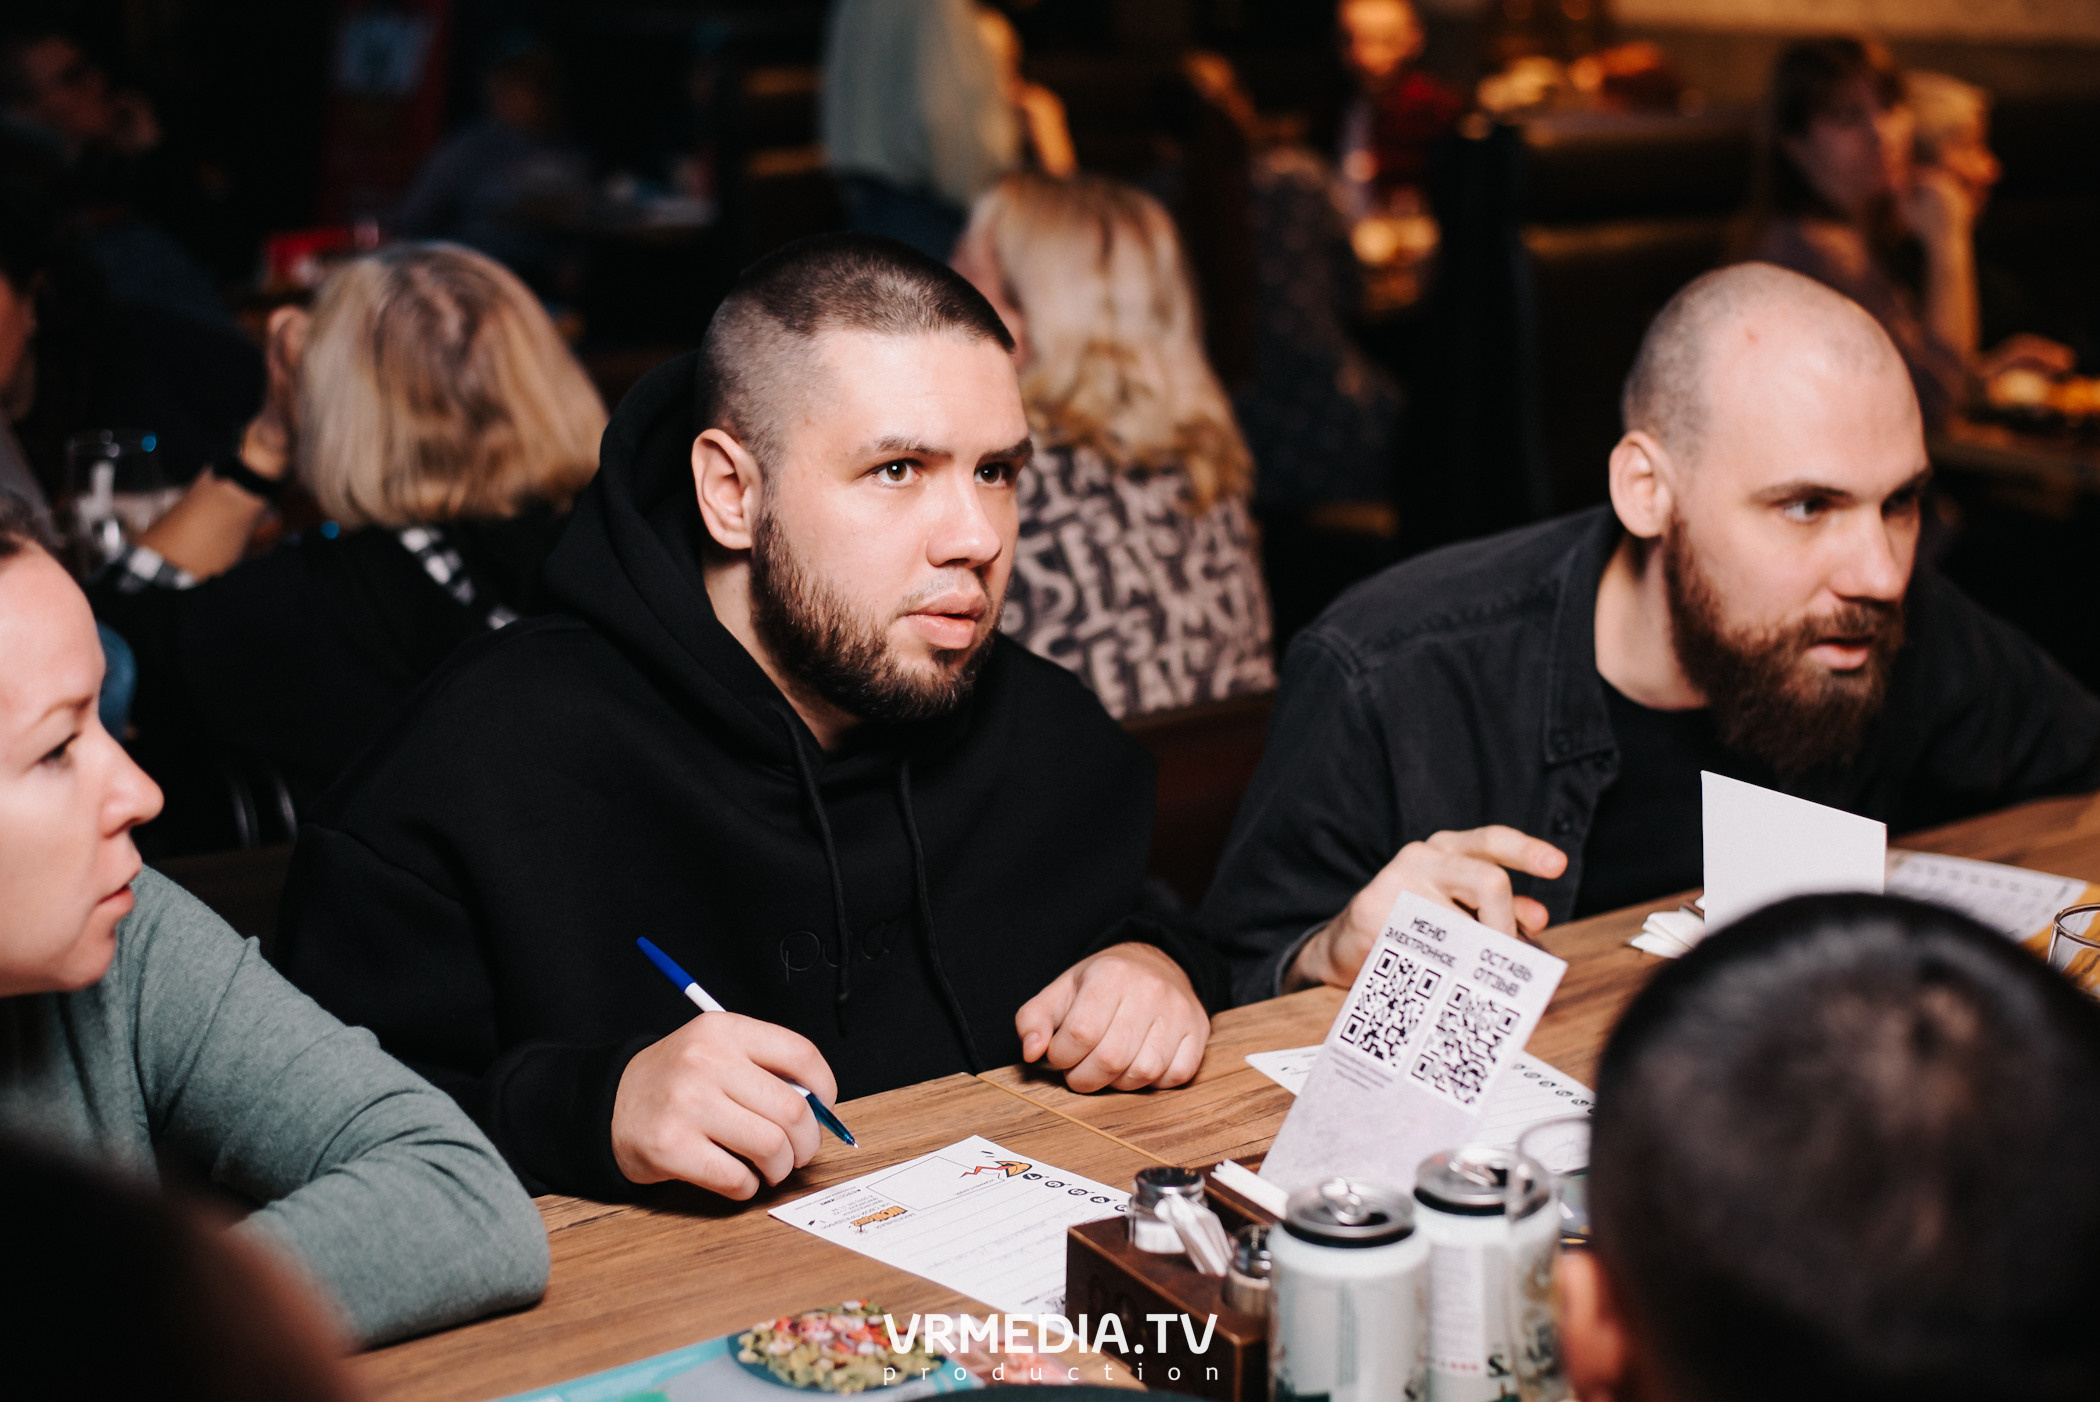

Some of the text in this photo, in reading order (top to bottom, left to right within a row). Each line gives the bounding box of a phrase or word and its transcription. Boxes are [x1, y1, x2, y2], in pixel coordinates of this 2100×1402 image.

[1410, 916, 1447, 942] МЕНЮ
[1479, 948, 1533, 982] ОСТАВЬ
[1473, 966, 1520, 997] ОТЗЫВ
